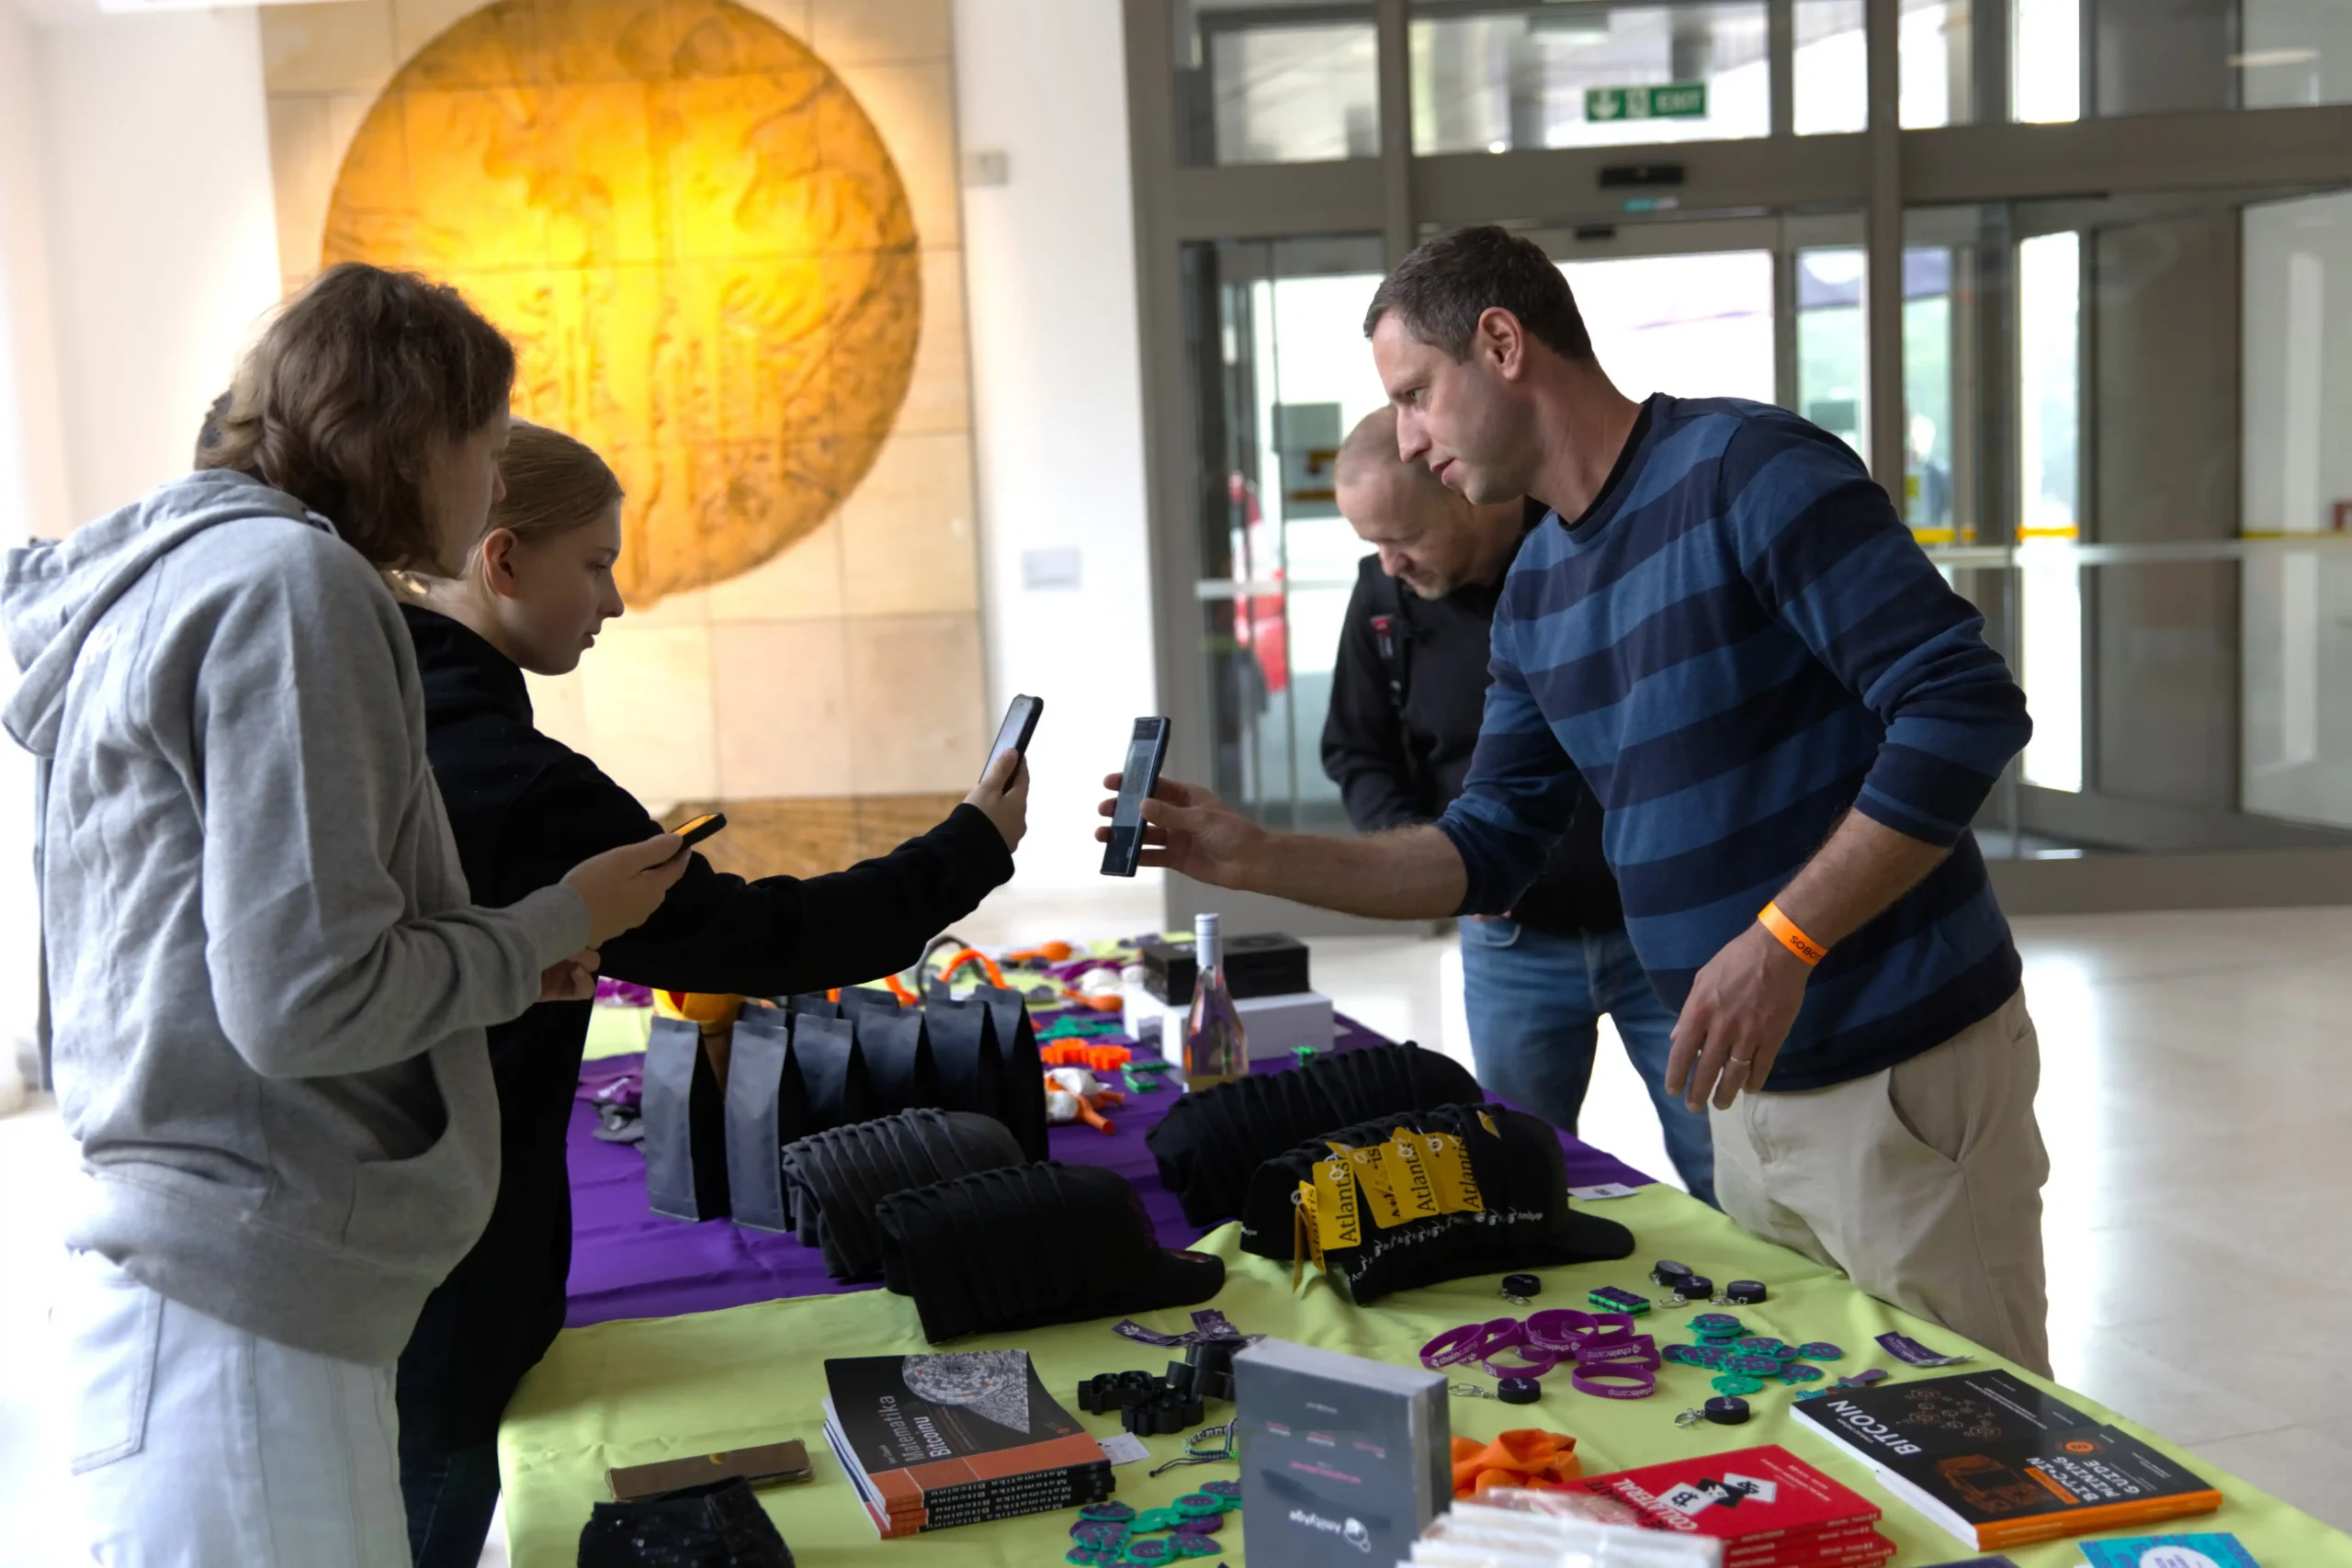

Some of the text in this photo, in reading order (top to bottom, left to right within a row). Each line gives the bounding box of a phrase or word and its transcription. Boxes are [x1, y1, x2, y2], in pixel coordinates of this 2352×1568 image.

[1656, 91, 1700, 112] EXIT
[1406, 1143, 1436, 1212] Atlantis
[1336, 1161, 1358, 1243] Atlantis
[1439, 1341, 1478, 1365] chaincamp
[1587, 1347, 1631, 1358] chaincamp
[878, 1395, 926, 1461] Matematika
[913, 1416, 952, 1457] Bitcoinu
[1826, 1400, 1922, 1455] BITCOIN
[930, 1478, 1067, 1505] Matematika Bitcoinu
[931, 1470, 1067, 1496] Matematika Bitcoinu
[2052, 1456, 2120, 1498] MINING
[2082, 1460, 2140, 1494] GUIDE
[934, 1494, 1071, 1521] Matematika Bitcoinu
[935, 1486, 1072, 1513] Matematika Bitcoinu
[1612, 1478, 1698, 1530] COLLATERAL
[926, 1503, 1063, 1529] Matematika Bitcoinu
